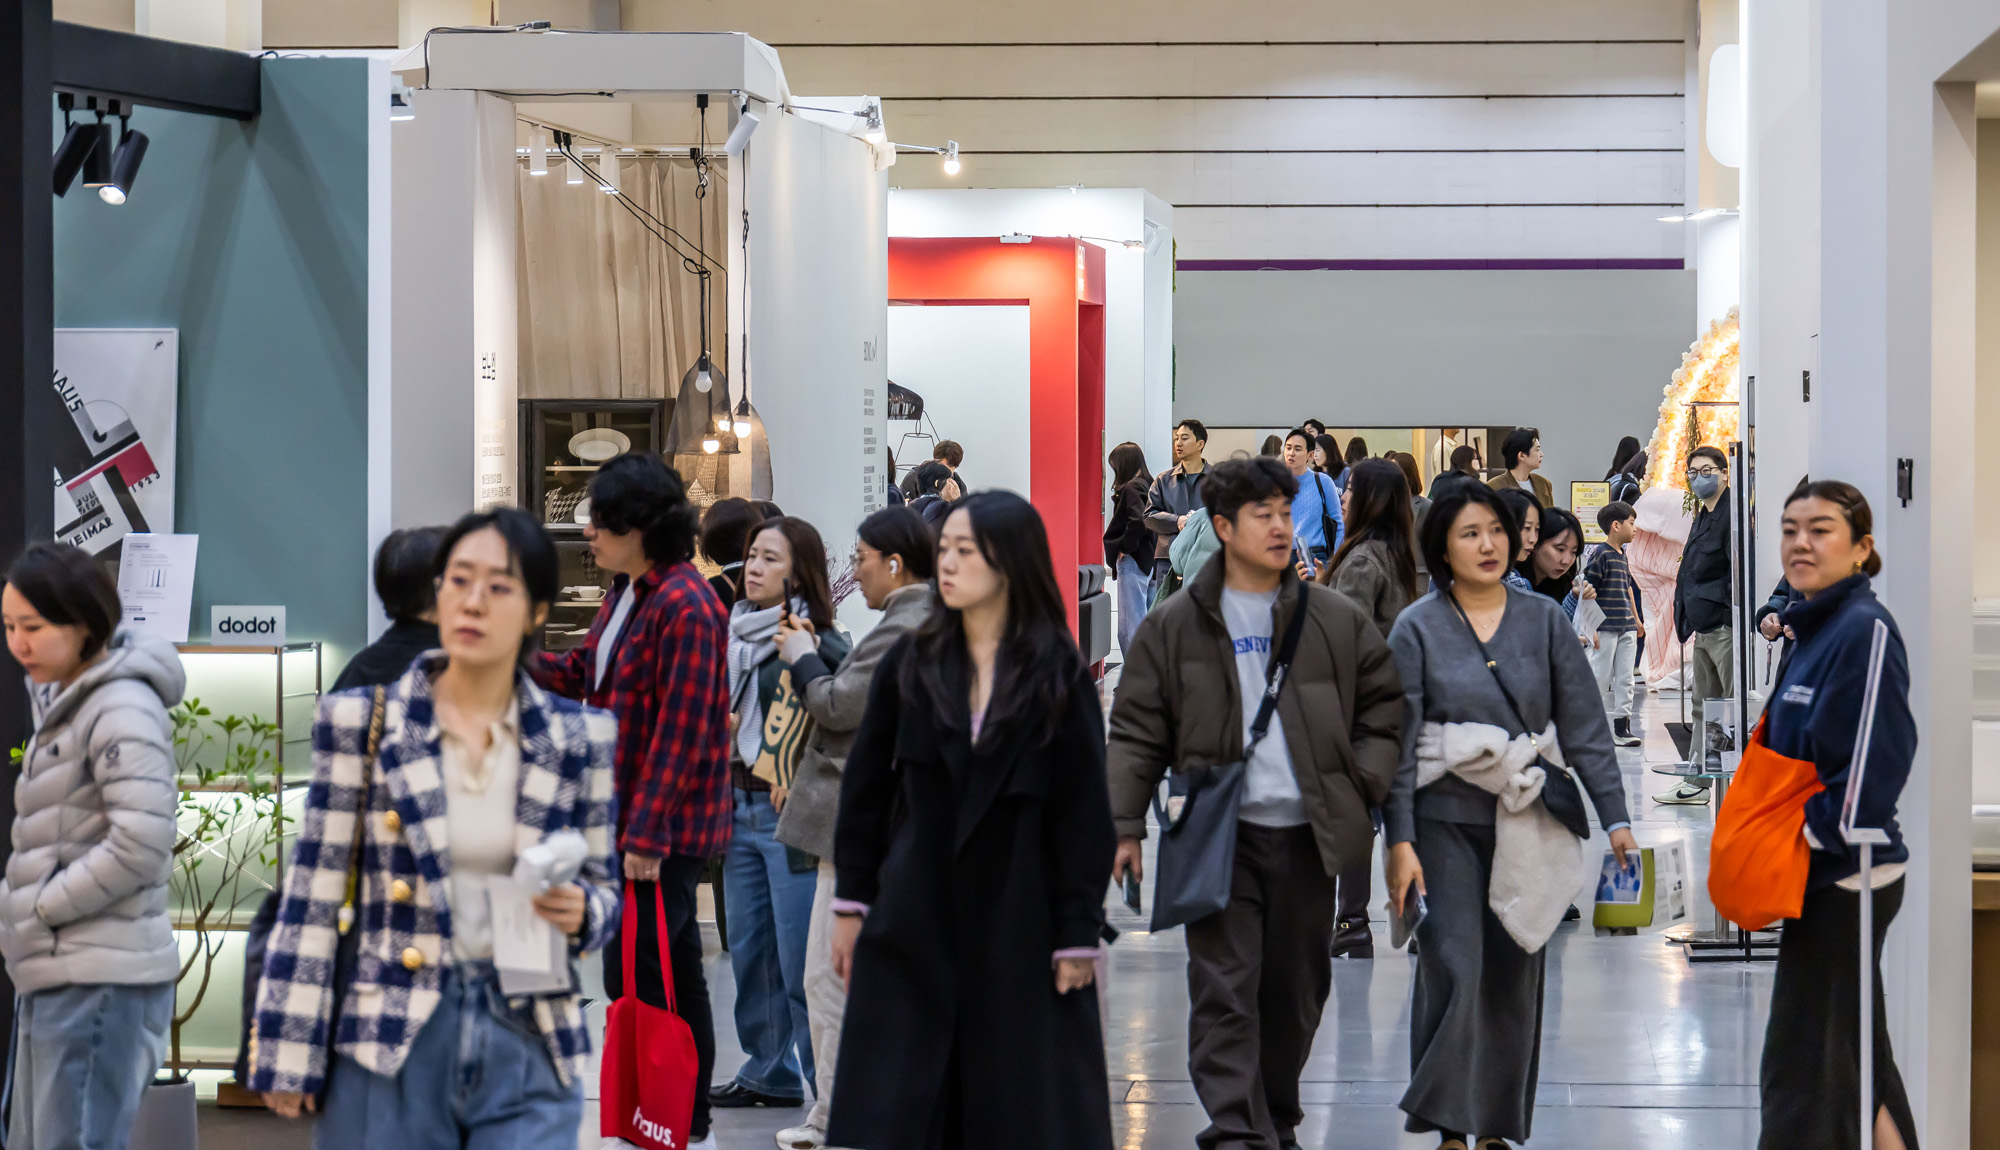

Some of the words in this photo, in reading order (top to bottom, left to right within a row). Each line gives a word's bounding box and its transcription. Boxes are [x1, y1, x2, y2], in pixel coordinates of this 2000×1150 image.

[54, 369, 84, 413] AUS
[132, 469, 161, 493] 1923
[218, 616, 276, 634] dodot
[632, 1106, 676, 1148] haus.
